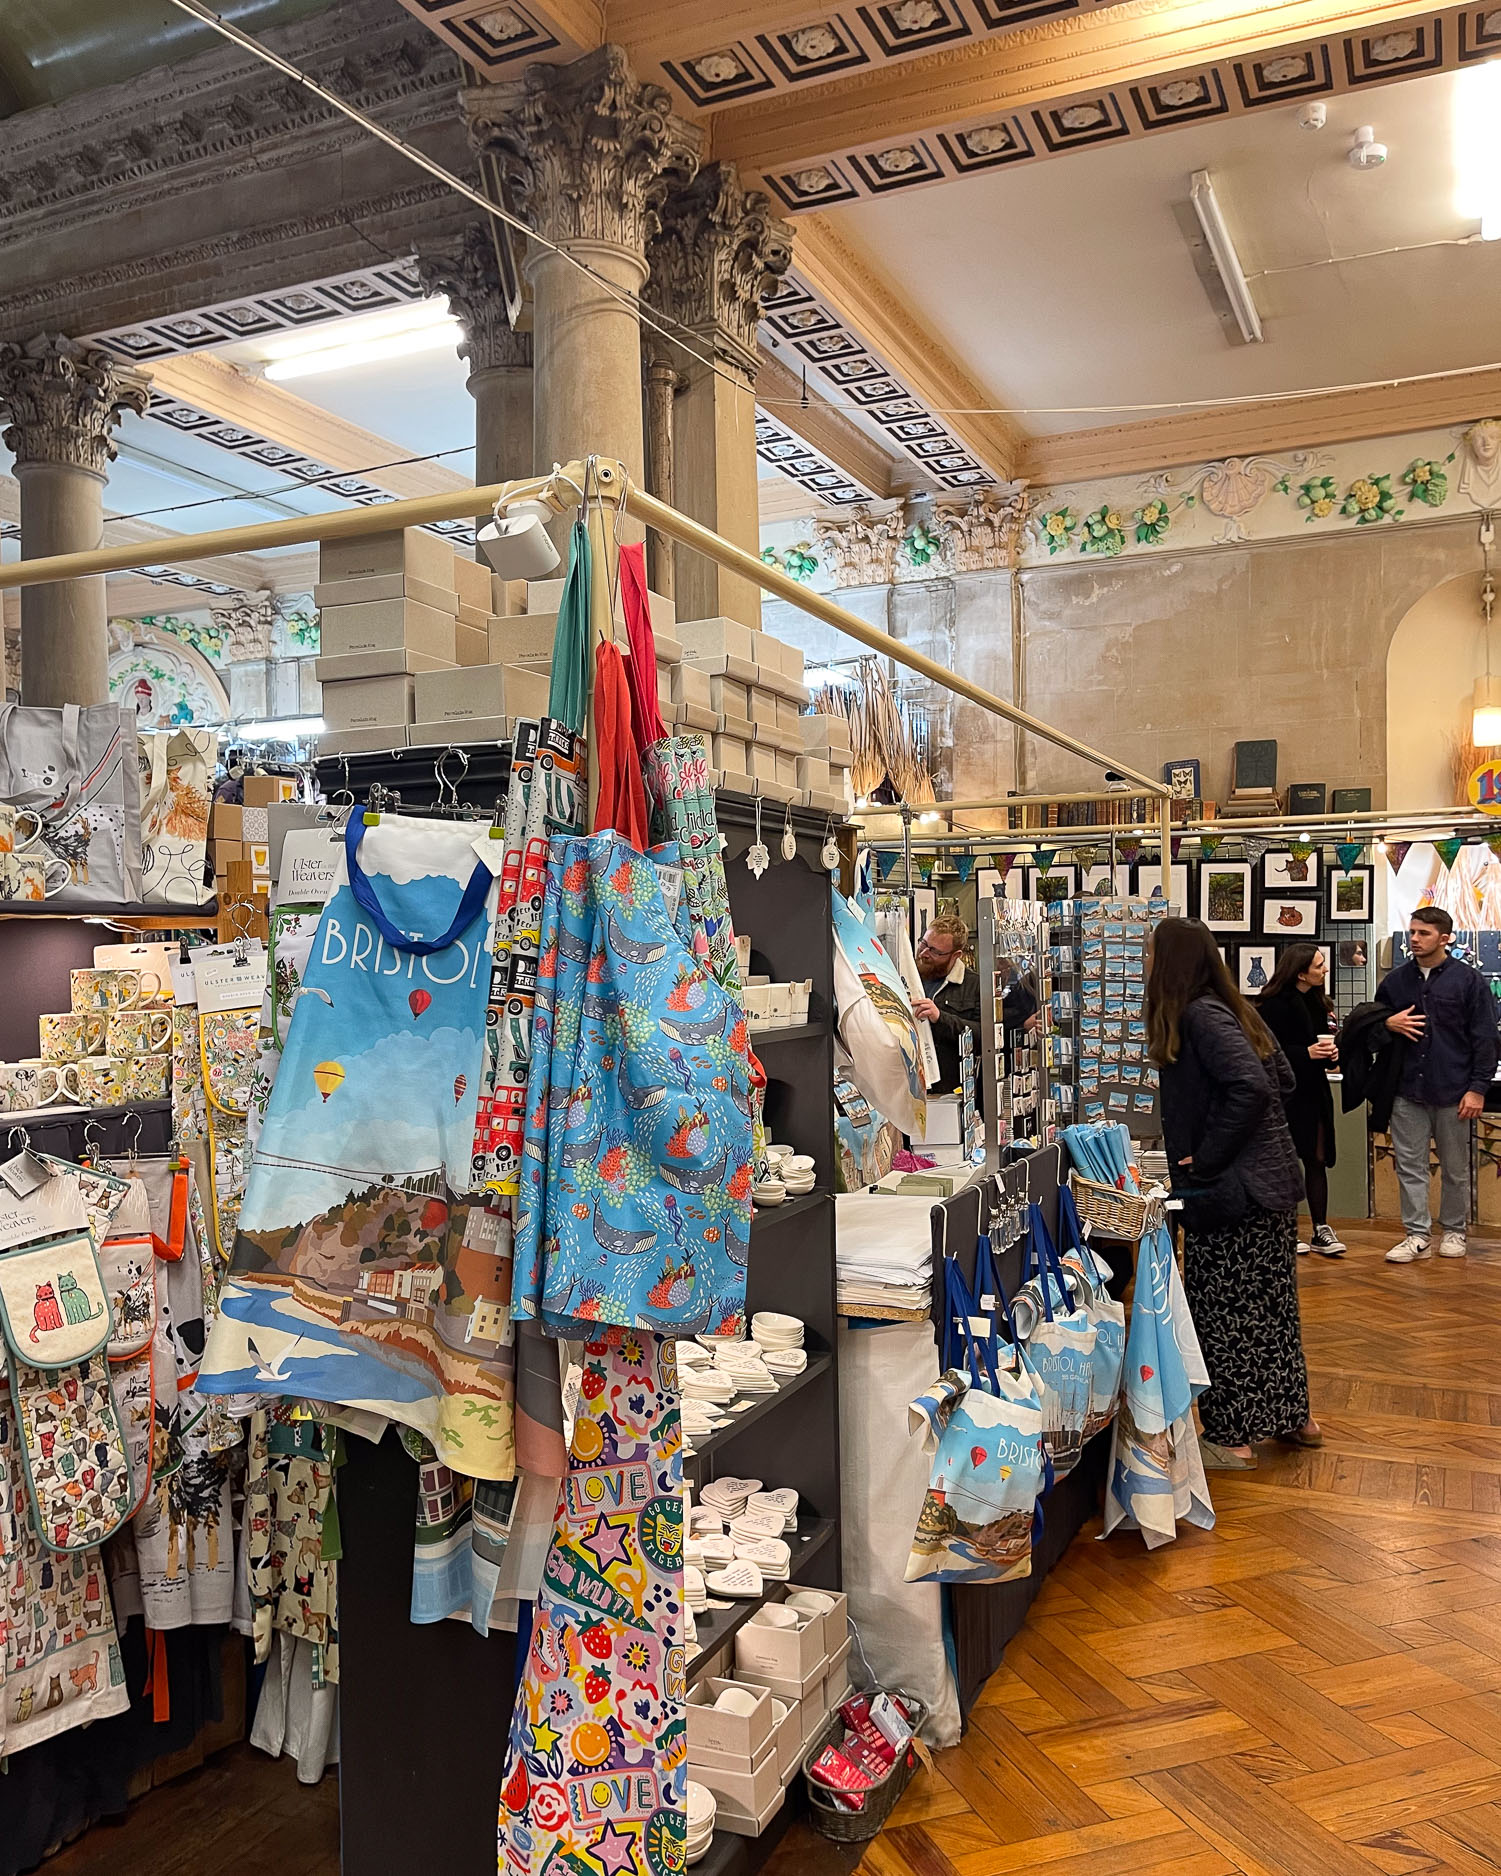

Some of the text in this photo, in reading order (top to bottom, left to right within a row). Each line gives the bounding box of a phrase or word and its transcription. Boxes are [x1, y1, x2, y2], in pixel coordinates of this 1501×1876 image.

[293, 858, 323, 870] Ulster
[292, 870, 335, 882] Weavers
[204, 977, 234, 986] ULSTER
